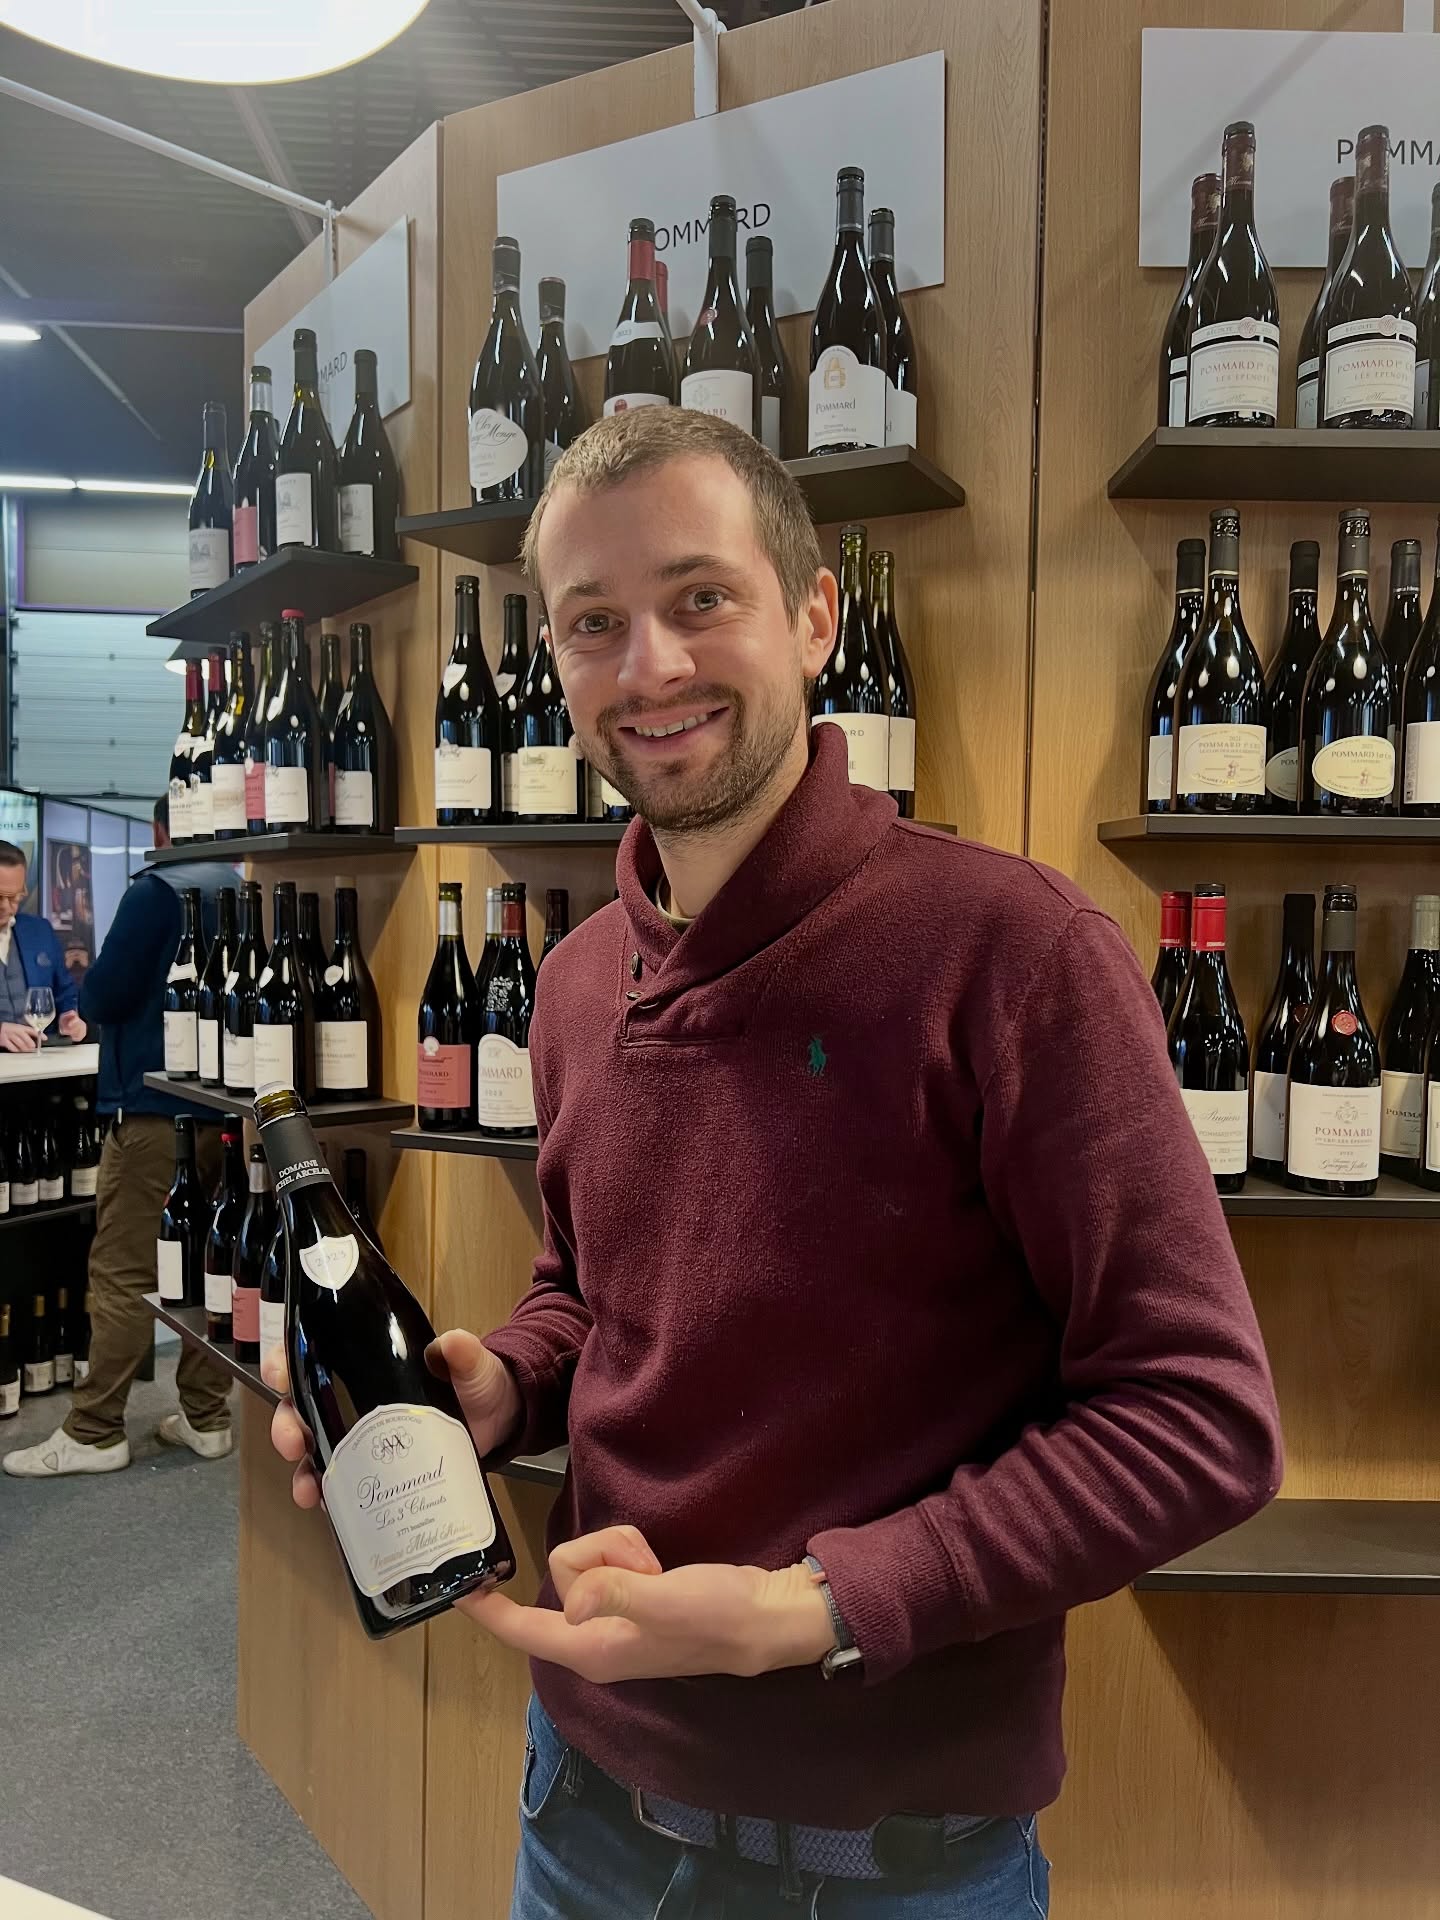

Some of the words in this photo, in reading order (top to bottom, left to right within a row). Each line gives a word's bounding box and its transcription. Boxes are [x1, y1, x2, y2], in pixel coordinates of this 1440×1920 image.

[1337, 139, 1440, 166] PMM
[654, 203, 771, 252] OMMRD
[1331, 751, 1375, 759] POMMARD
[480, 1066, 523, 1080] MMARD
[1315, 1126, 1373, 1137] POMMARD
[279, 1159, 319, 1179] DOMAINE
[356, 1455, 444, 1510] Pommard
